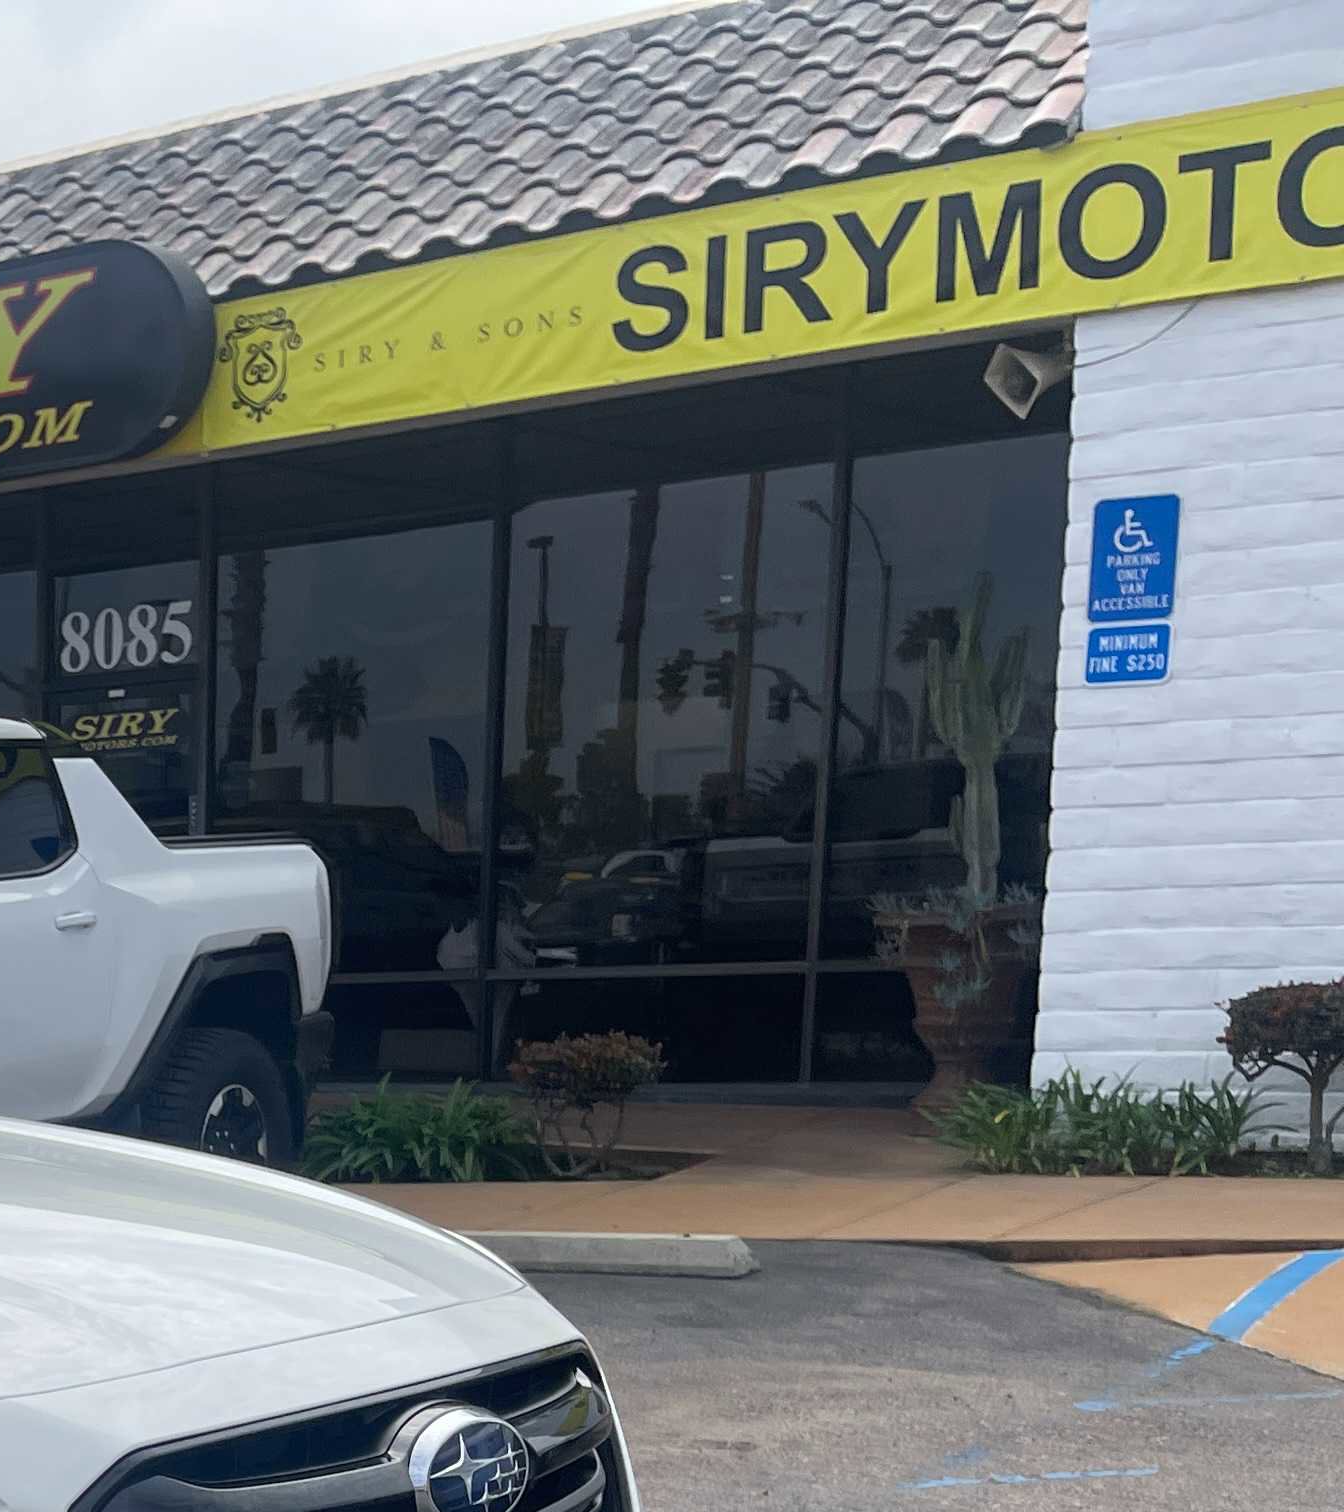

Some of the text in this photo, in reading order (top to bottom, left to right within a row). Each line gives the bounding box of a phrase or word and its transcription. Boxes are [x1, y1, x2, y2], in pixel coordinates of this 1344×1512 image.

[313, 339, 399, 373] SIRY
[476, 305, 584, 343] SONS
[1106, 552, 1160, 569] PARKING
[1117, 568, 1148, 583] ONLY
[1092, 594, 1169, 613] ACCESSIBLE
[60, 600, 193, 673] 8085
[1099, 632, 1158, 652] MINIMUM
[1089, 653, 1165, 673] FINE $250
[71, 708, 180, 741] SIRY
